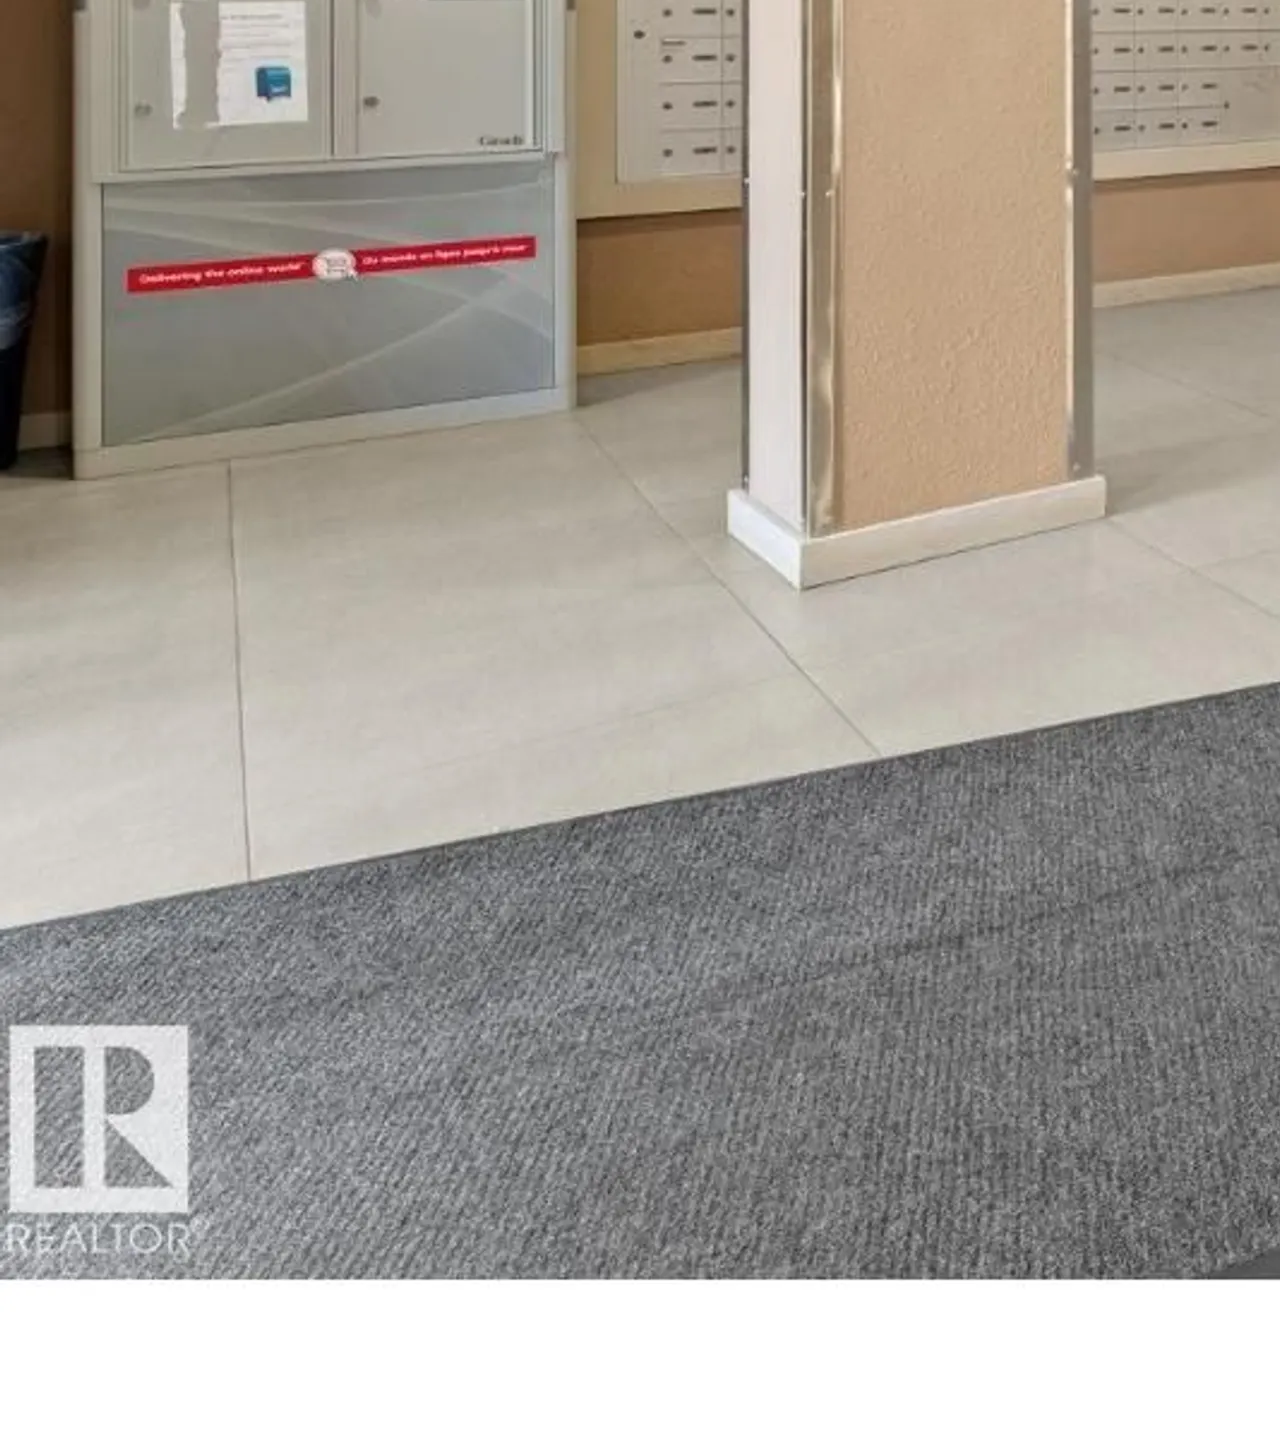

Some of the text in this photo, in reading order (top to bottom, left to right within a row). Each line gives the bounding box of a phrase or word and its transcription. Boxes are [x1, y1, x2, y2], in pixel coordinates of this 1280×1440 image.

[138, 270, 202, 285] Delivering
[204, 268, 224, 279] the
[227, 265, 264, 278] online
